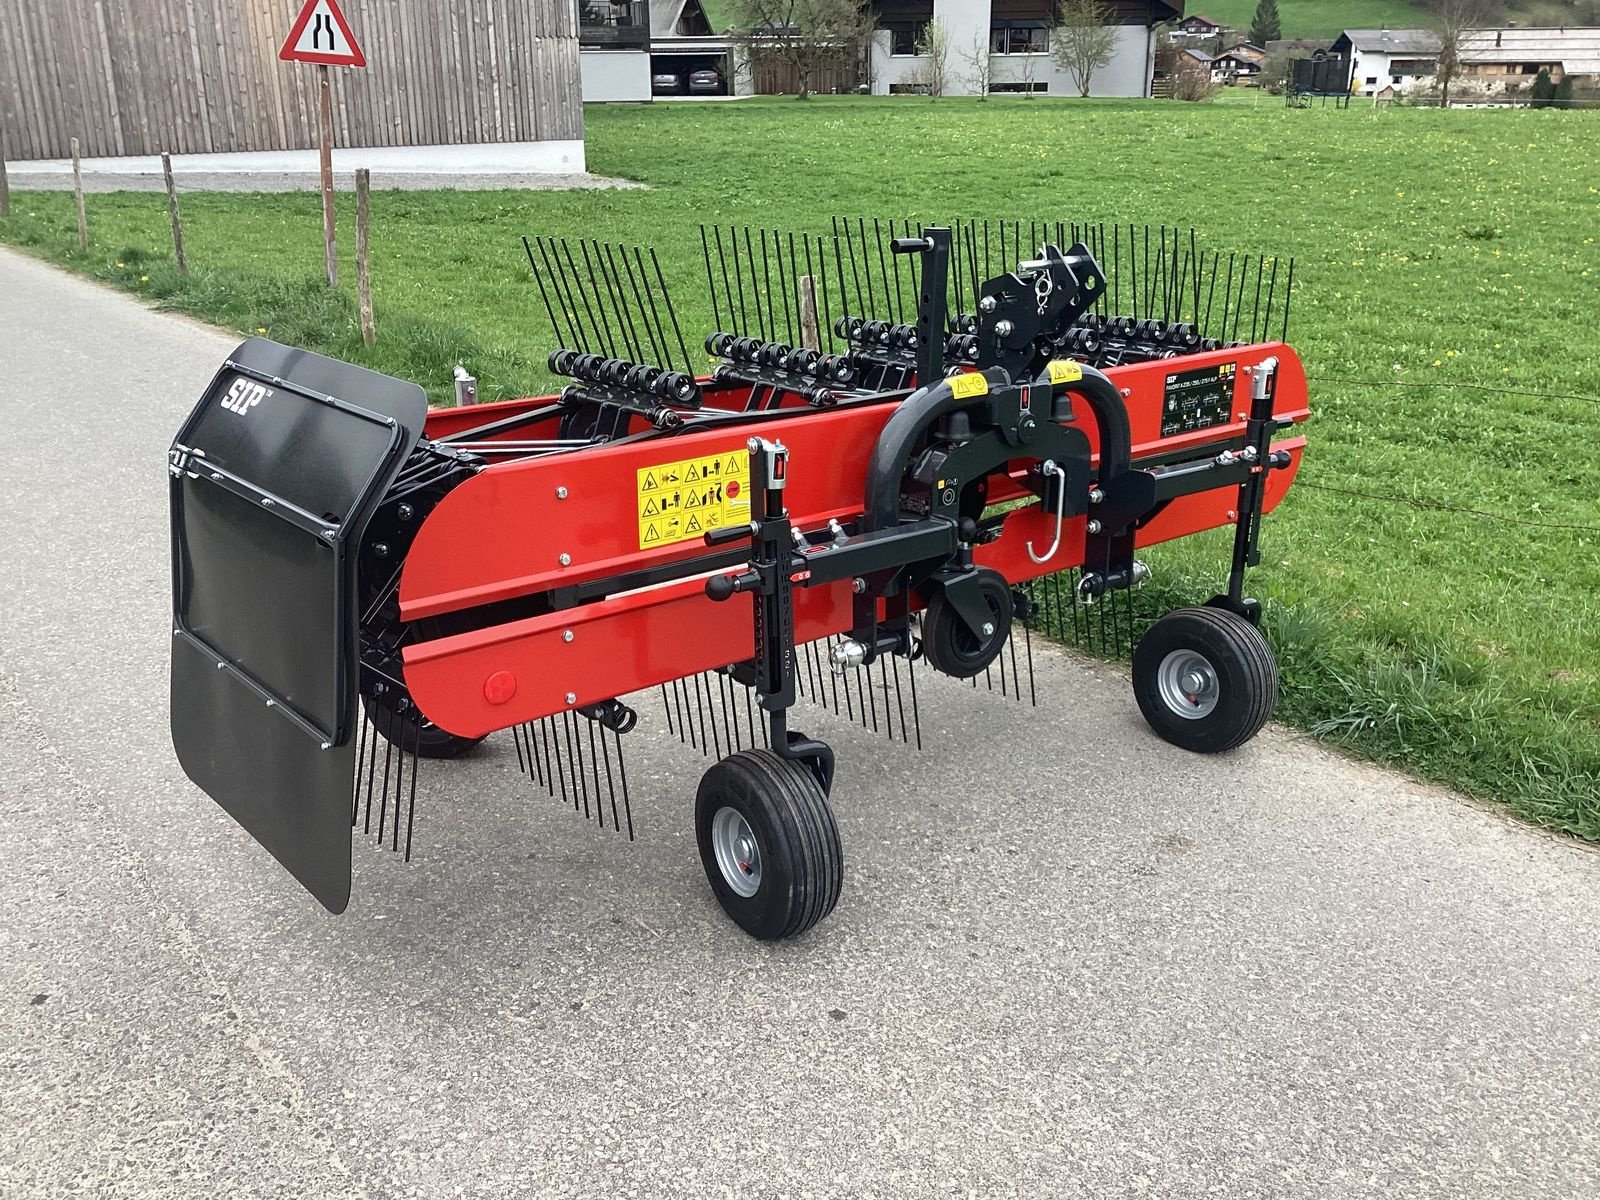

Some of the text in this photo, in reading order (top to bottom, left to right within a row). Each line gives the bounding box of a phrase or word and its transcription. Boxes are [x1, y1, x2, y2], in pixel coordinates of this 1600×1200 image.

[220, 378, 266, 416] SIP
[784, 650, 789, 658] 3
[785, 660, 790, 668] 2
